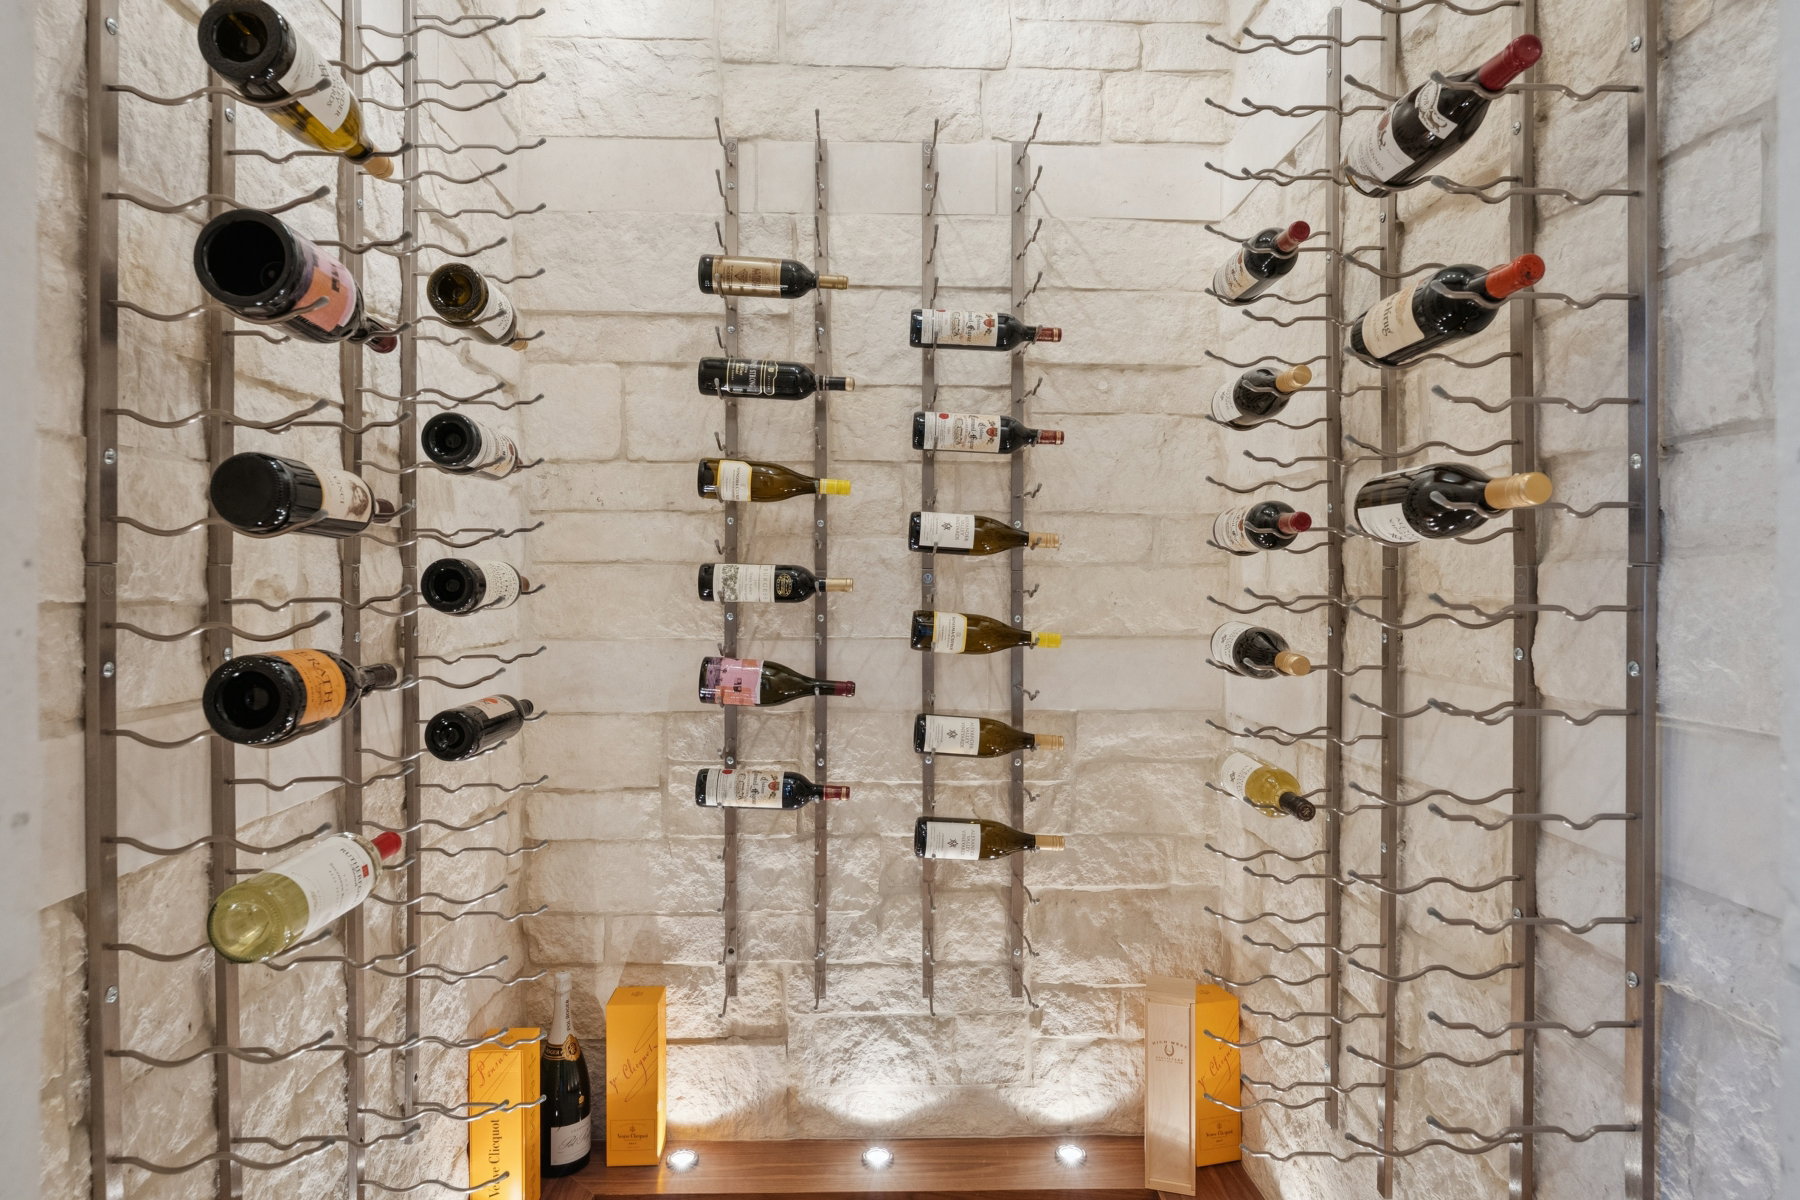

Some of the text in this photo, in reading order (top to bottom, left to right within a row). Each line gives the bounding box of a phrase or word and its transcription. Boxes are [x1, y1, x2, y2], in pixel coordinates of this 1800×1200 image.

[748, 369, 757, 388] STRONG
[488, 1119, 503, 1198] Veve Clicquot
